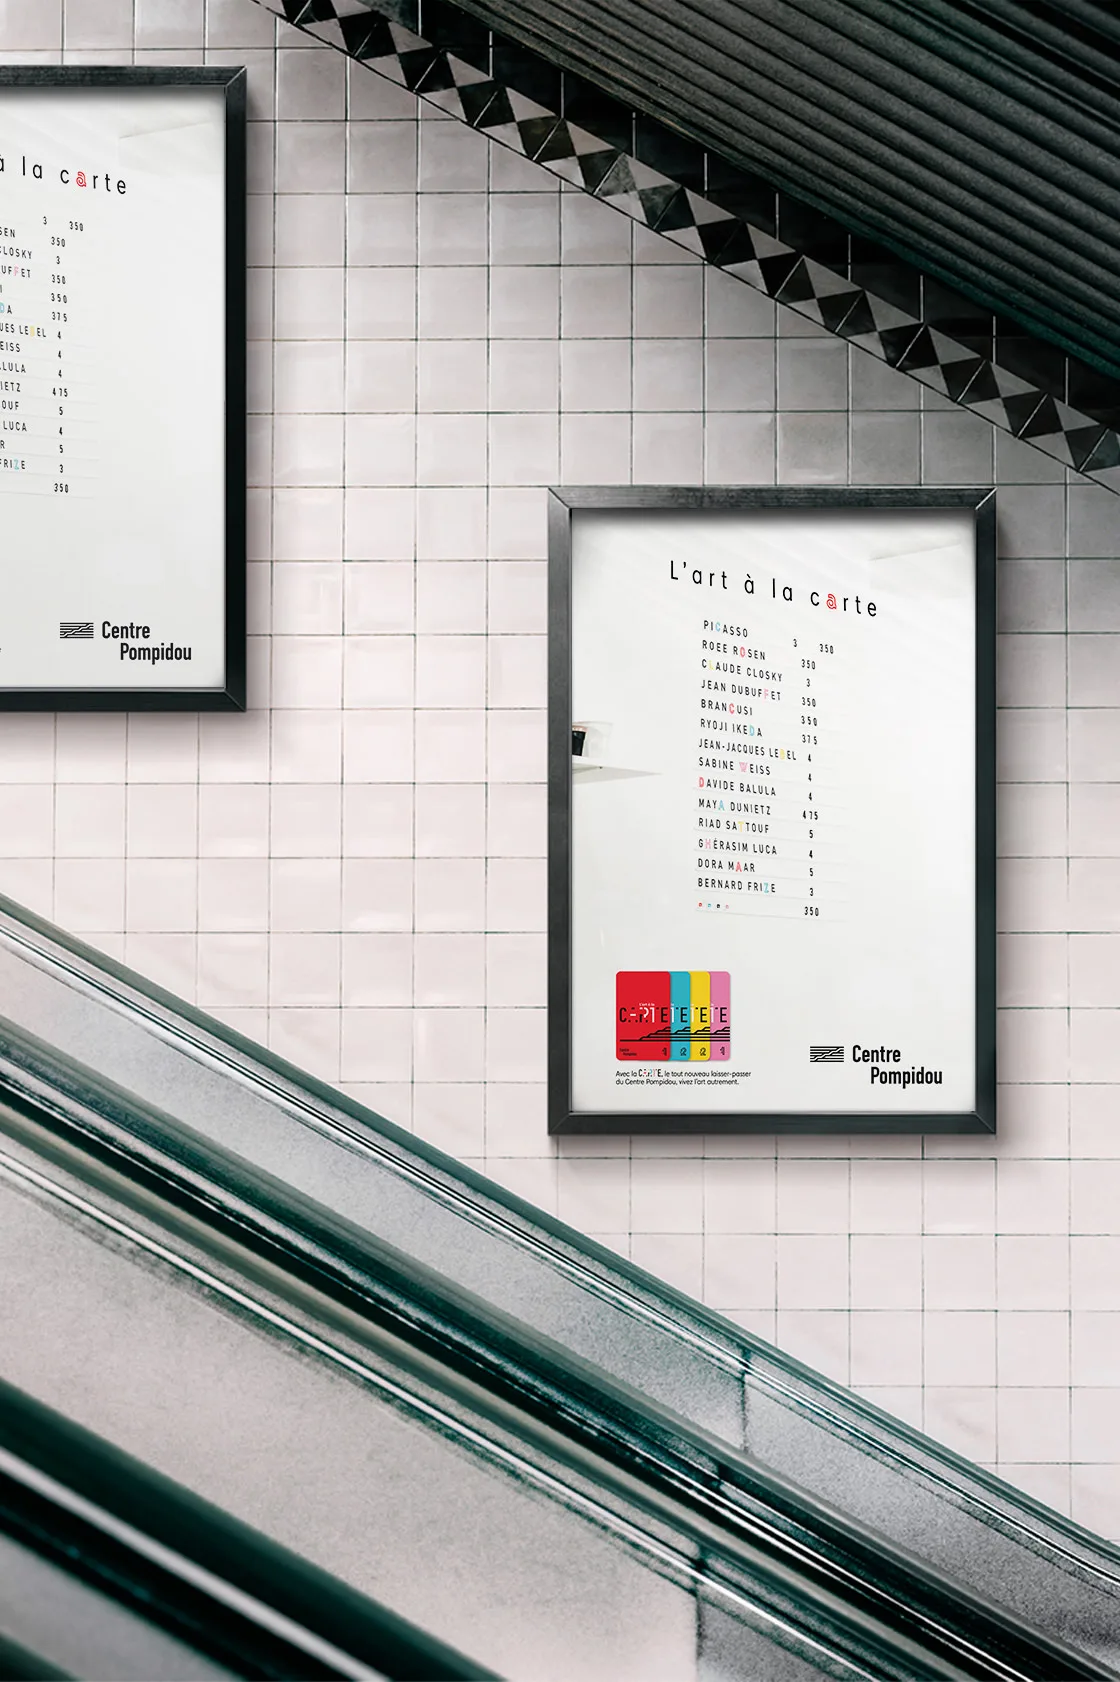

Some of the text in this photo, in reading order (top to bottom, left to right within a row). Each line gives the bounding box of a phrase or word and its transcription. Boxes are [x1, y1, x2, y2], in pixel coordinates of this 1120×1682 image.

[22, 155, 43, 180] la
[59, 168, 127, 195] carte
[42, 215, 84, 232] 3 350
[50, 235, 66, 248] 350
[55, 255, 61, 265] 3
[51, 273, 67, 285] 350
[50, 292, 68, 305] 350
[56, 330, 62, 340] 4
[57, 349, 62, 360] 4
[0, 361, 27, 374] LULA
[57, 368, 63, 379] 4
[58, 405, 64, 416] 5
[2, 420, 28, 433] LUCA
[58, 426, 64, 436] 4
[58, 443, 64, 454] 5
[58, 463, 64, 474] 3
[53, 482, 70, 494] 350
[743, 572, 755, 595] à
[771, 577, 793, 602] la
[809, 591, 877, 618] carte
[102, 621, 150, 639] Centre
[703, 619, 749, 639] PICASSO
[701, 639, 766, 661] ROEE ROSEN
[792, 638, 835, 655] 3 350
[120, 642, 191, 665] Pompidou
[701, 658, 783, 683] CLAUDE CLOSKY
[800, 658, 816, 671] 350
[805, 677, 811, 688] 3
[700, 679, 781, 701] JEAN DUBUFFET
[700, 698, 753, 716] BRANCUSI
[801, 696, 817, 708] 350
[800, 714, 818, 727] 350
[700, 717, 763, 738] RYOJI IKEDA
[698, 737, 766, 757] JEAN-JACQUES
[807, 753, 812, 763] 4
[698, 756, 771, 776] SABINE WEISS
[807, 772, 813, 783] 4
[698, 776, 777, 797] DAVIDE BALULA
[807, 791, 813, 802] 4
[698, 797, 771, 816] MAYA DUNIETZ
[698, 816, 770, 834] RIAD SATTOUF
[808, 829, 814, 839] 5
[752, 843, 778, 856] LUCA
[808, 849, 814, 860] 4
[697, 857, 756, 873] DORA MAAR
[808, 867, 814, 878] 5
[697, 877, 776, 894] BERNARD FRIZE
[809, 887, 815, 897] 3
[803, 905, 820, 917] 350
[853, 1045, 901, 1063] Centre
[871, 1066, 942, 1089] Pompidou
